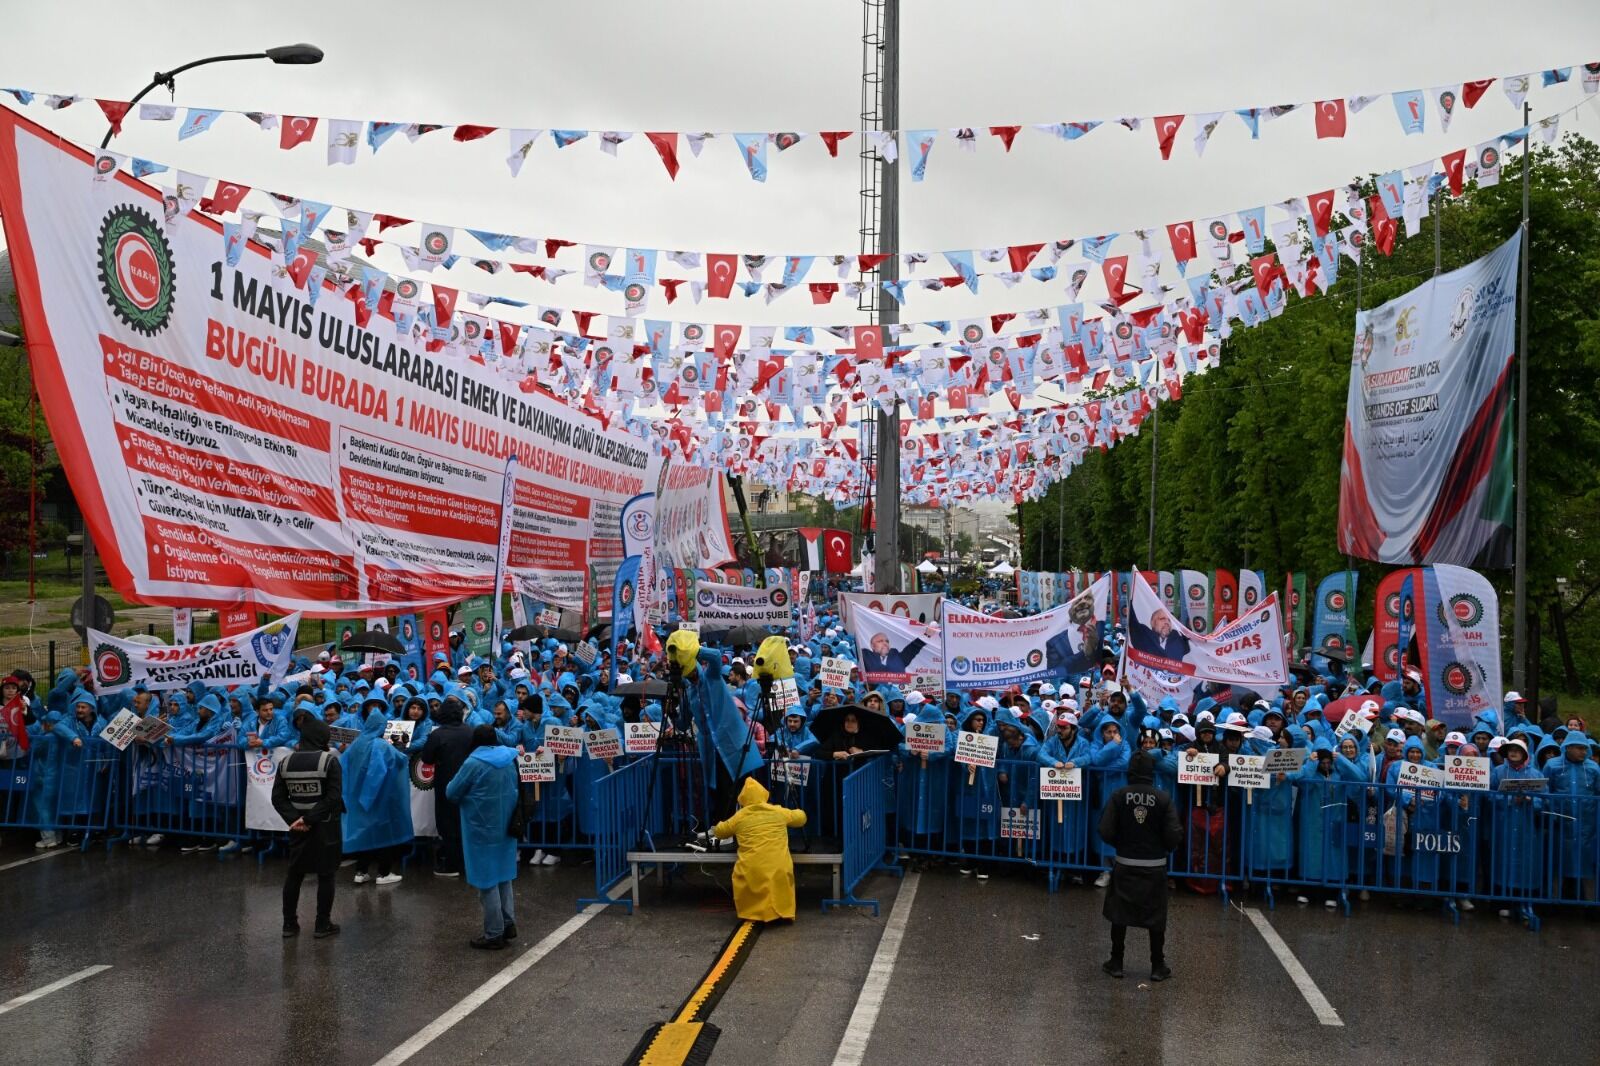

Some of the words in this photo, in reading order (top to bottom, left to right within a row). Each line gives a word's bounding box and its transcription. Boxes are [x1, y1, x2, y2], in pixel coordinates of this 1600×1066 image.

[210, 261, 224, 301] 1
[233, 270, 314, 340] MAYIS
[318, 311, 458, 400] ULUSLARARASI
[461, 376, 499, 417] EMEK
[502, 394, 517, 423] VE
[518, 402, 572, 446] DAYANIŞMA
[573, 424, 595, 453] GÜNÜ
[140, 356, 158, 373] Bir
[189, 377, 201, 388] ve
[205, 318, 296, 389] BUGÜN
[302, 358, 388, 422] BURADA
[394, 397, 405, 427] 1
[409, 400, 458, 445] MAYIS
[545, 452, 567, 480] EMEK
[569, 462, 579, 484] VE
[1395, 400, 1410, 416] OFF
[350, 436, 379, 453] Başkenti
[698, 611, 733, 619] ANKARA
[741, 612, 764, 620] NOLU
[766, 611, 788, 621] ŞUBE
[547, 741, 580, 749] EMEKÇİLER
[1185, 764, 1199, 773] EŞİT
[1200, 764, 1211, 773] İŞE
[1179, 773, 1193, 782] EŞİT
[981, 804, 993, 812] 59
[1364, 832, 1377, 840] 59
[1415, 832, 1461, 853] POLİS
